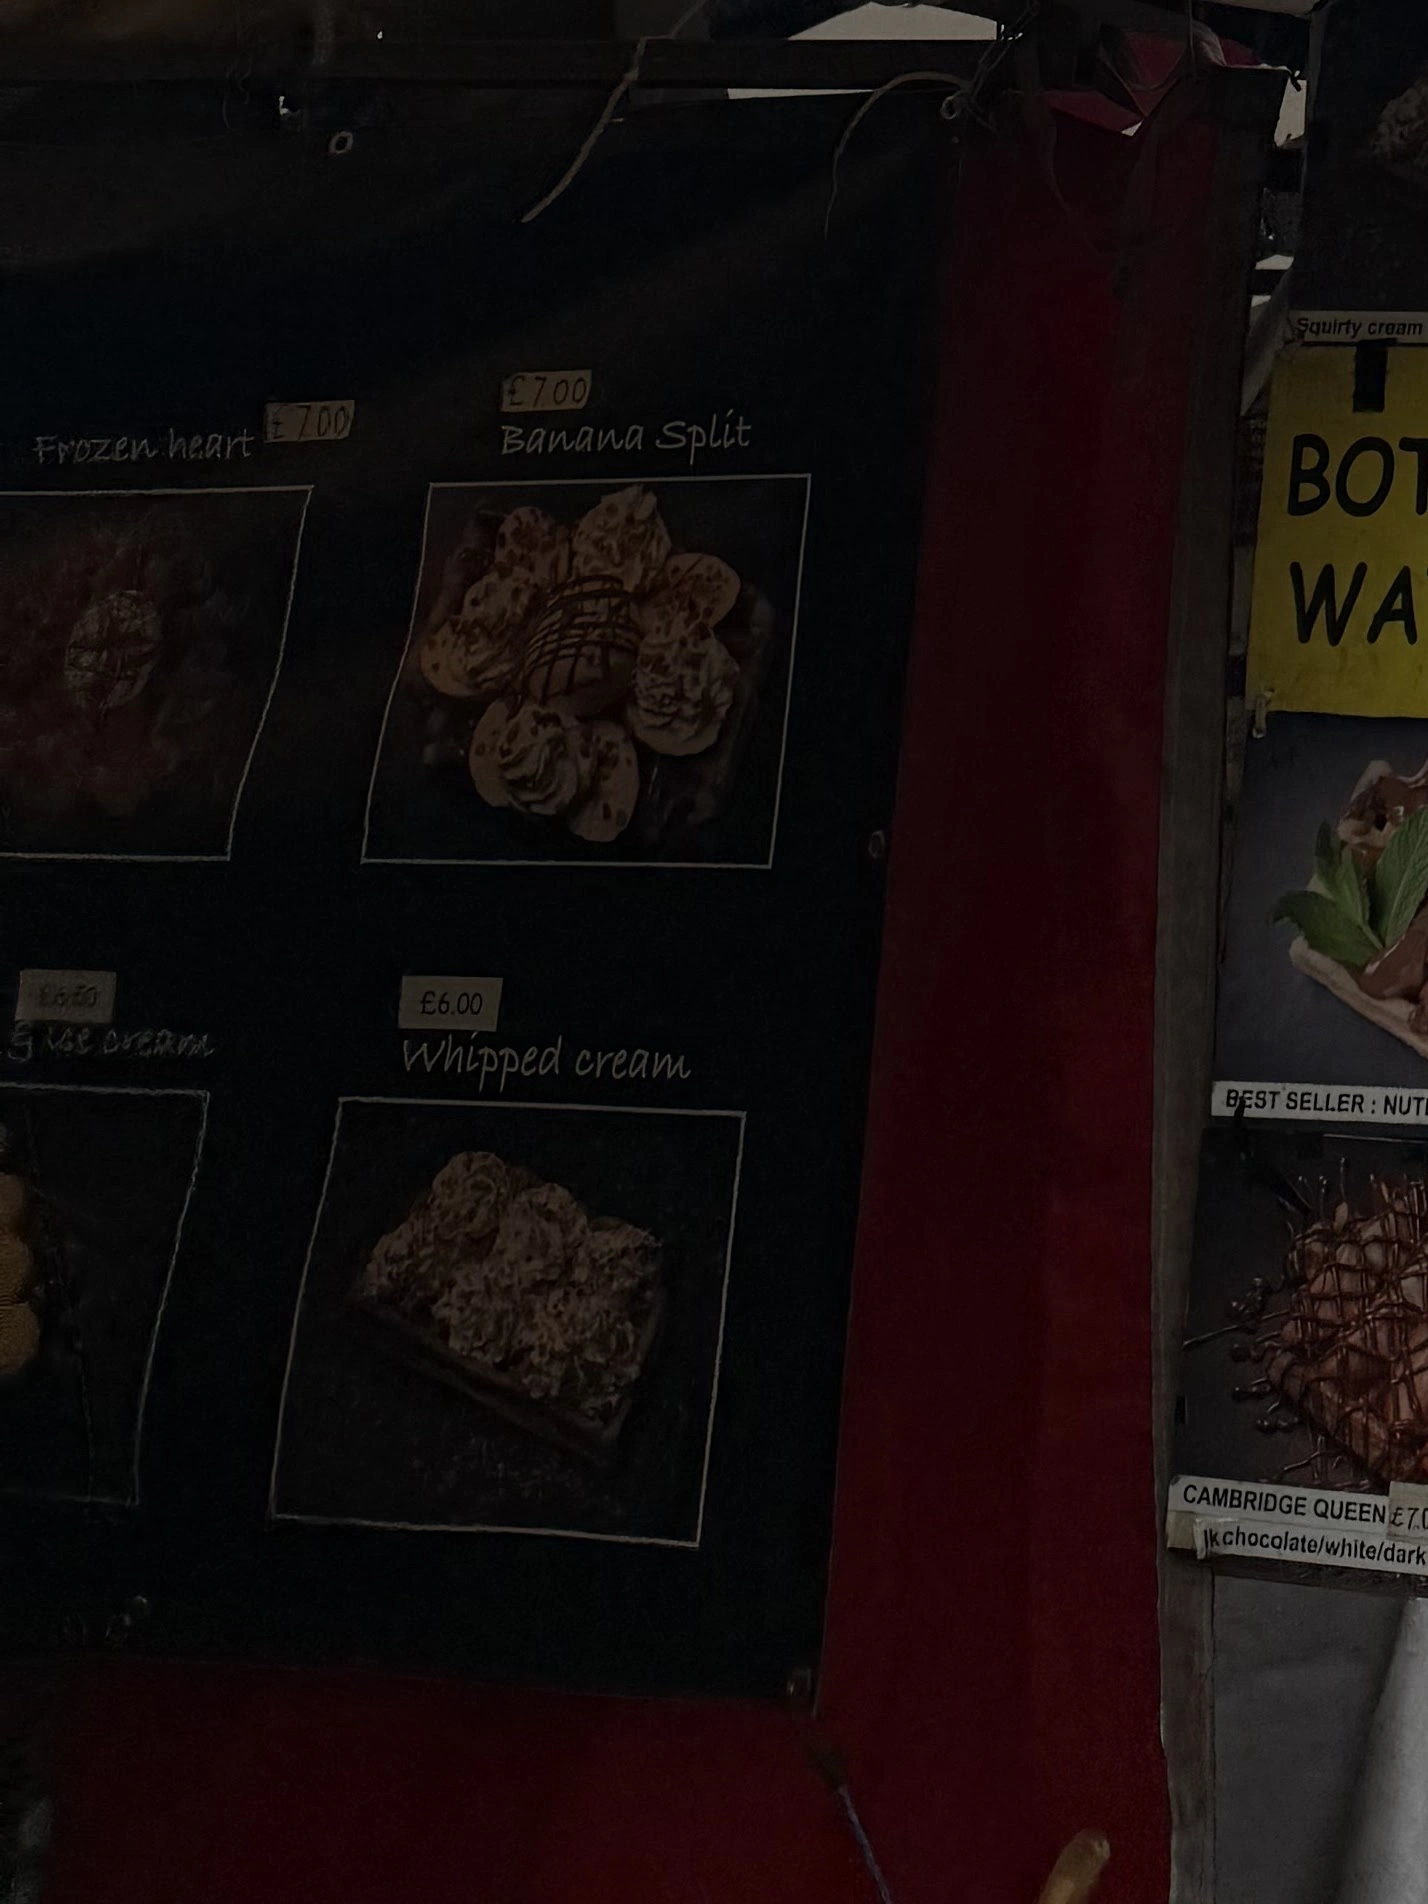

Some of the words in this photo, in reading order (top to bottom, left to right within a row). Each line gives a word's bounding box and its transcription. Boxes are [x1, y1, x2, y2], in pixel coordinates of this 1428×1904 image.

[1298, 316, 1362, 339] Squirty
[1367, 320, 1423, 336] cream
[33, 434, 158, 465] Frozen
[167, 431, 255, 461] heart
[500, 423, 645, 455] Banana
[654, 408, 751, 466] Split
[420, 990, 484, 1016] £6.00
[402, 1031, 563, 1094] Whipped
[574, 1050, 692, 1079] cream
[1225, 1088, 1277, 1111] BEST
[1286, 1091, 1365, 1115] SELLER
[1182, 1483, 1307, 1517] CAMBRIDGE
[1313, 1498, 1387, 1526] QUEEN
